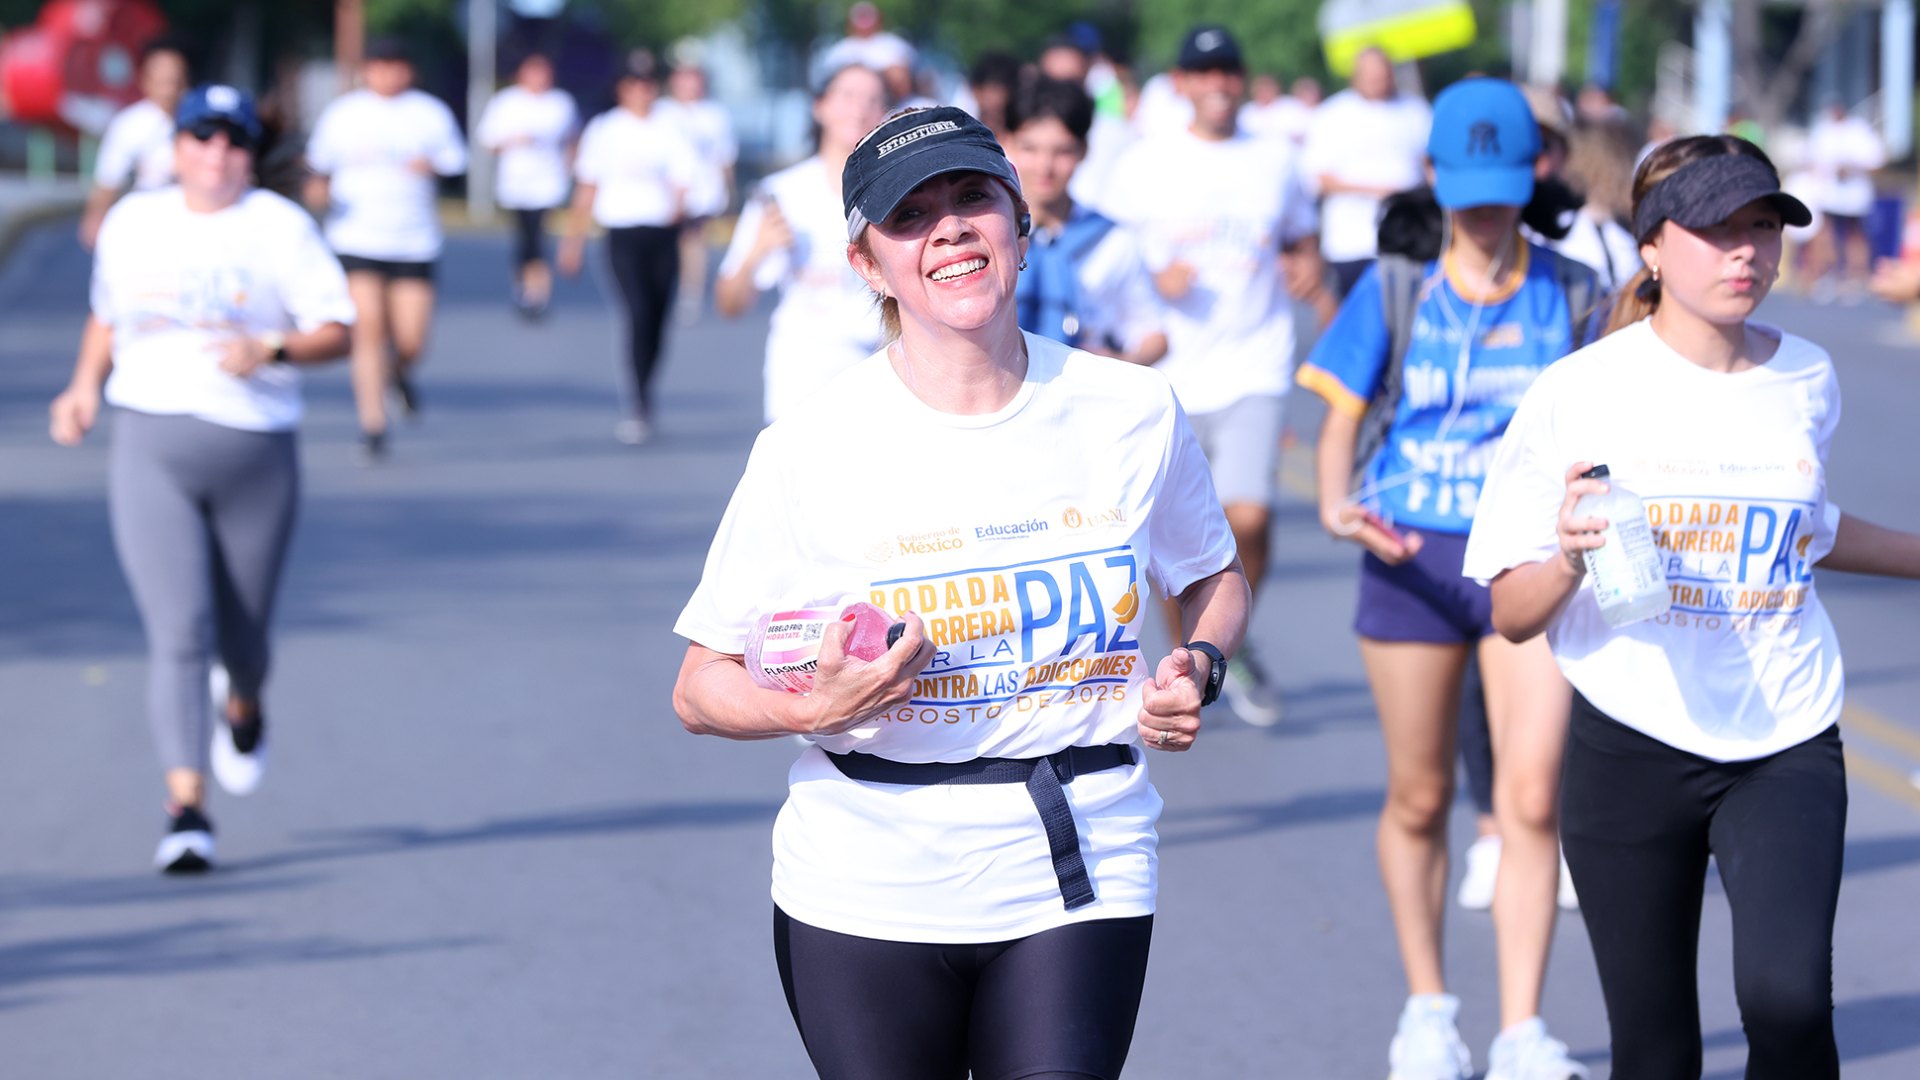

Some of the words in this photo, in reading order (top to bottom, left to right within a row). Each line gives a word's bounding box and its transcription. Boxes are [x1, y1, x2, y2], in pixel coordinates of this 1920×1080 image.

[1648, 503, 1739, 527] ODADA
[975, 518, 1049, 539] Educación
[899, 537, 964, 556] México
[1699, 556, 1732, 576] LA
[1669, 583, 1704, 607] TRA
[1706, 587, 1734, 609] LAS
[1014, 554, 1140, 664] PAZ
[1654, 611, 1722, 631] OSTO
[923, 608, 1016, 647] RRERA
[970, 638, 1014, 661] LA
[912, 674, 979, 699] ONTRA
[983, 670, 1019, 696] LAS
[1023, 655, 1137, 689] ADICCIONES
[1017, 692, 1054, 712] DE
[1064, 685, 1126, 705] 2025
